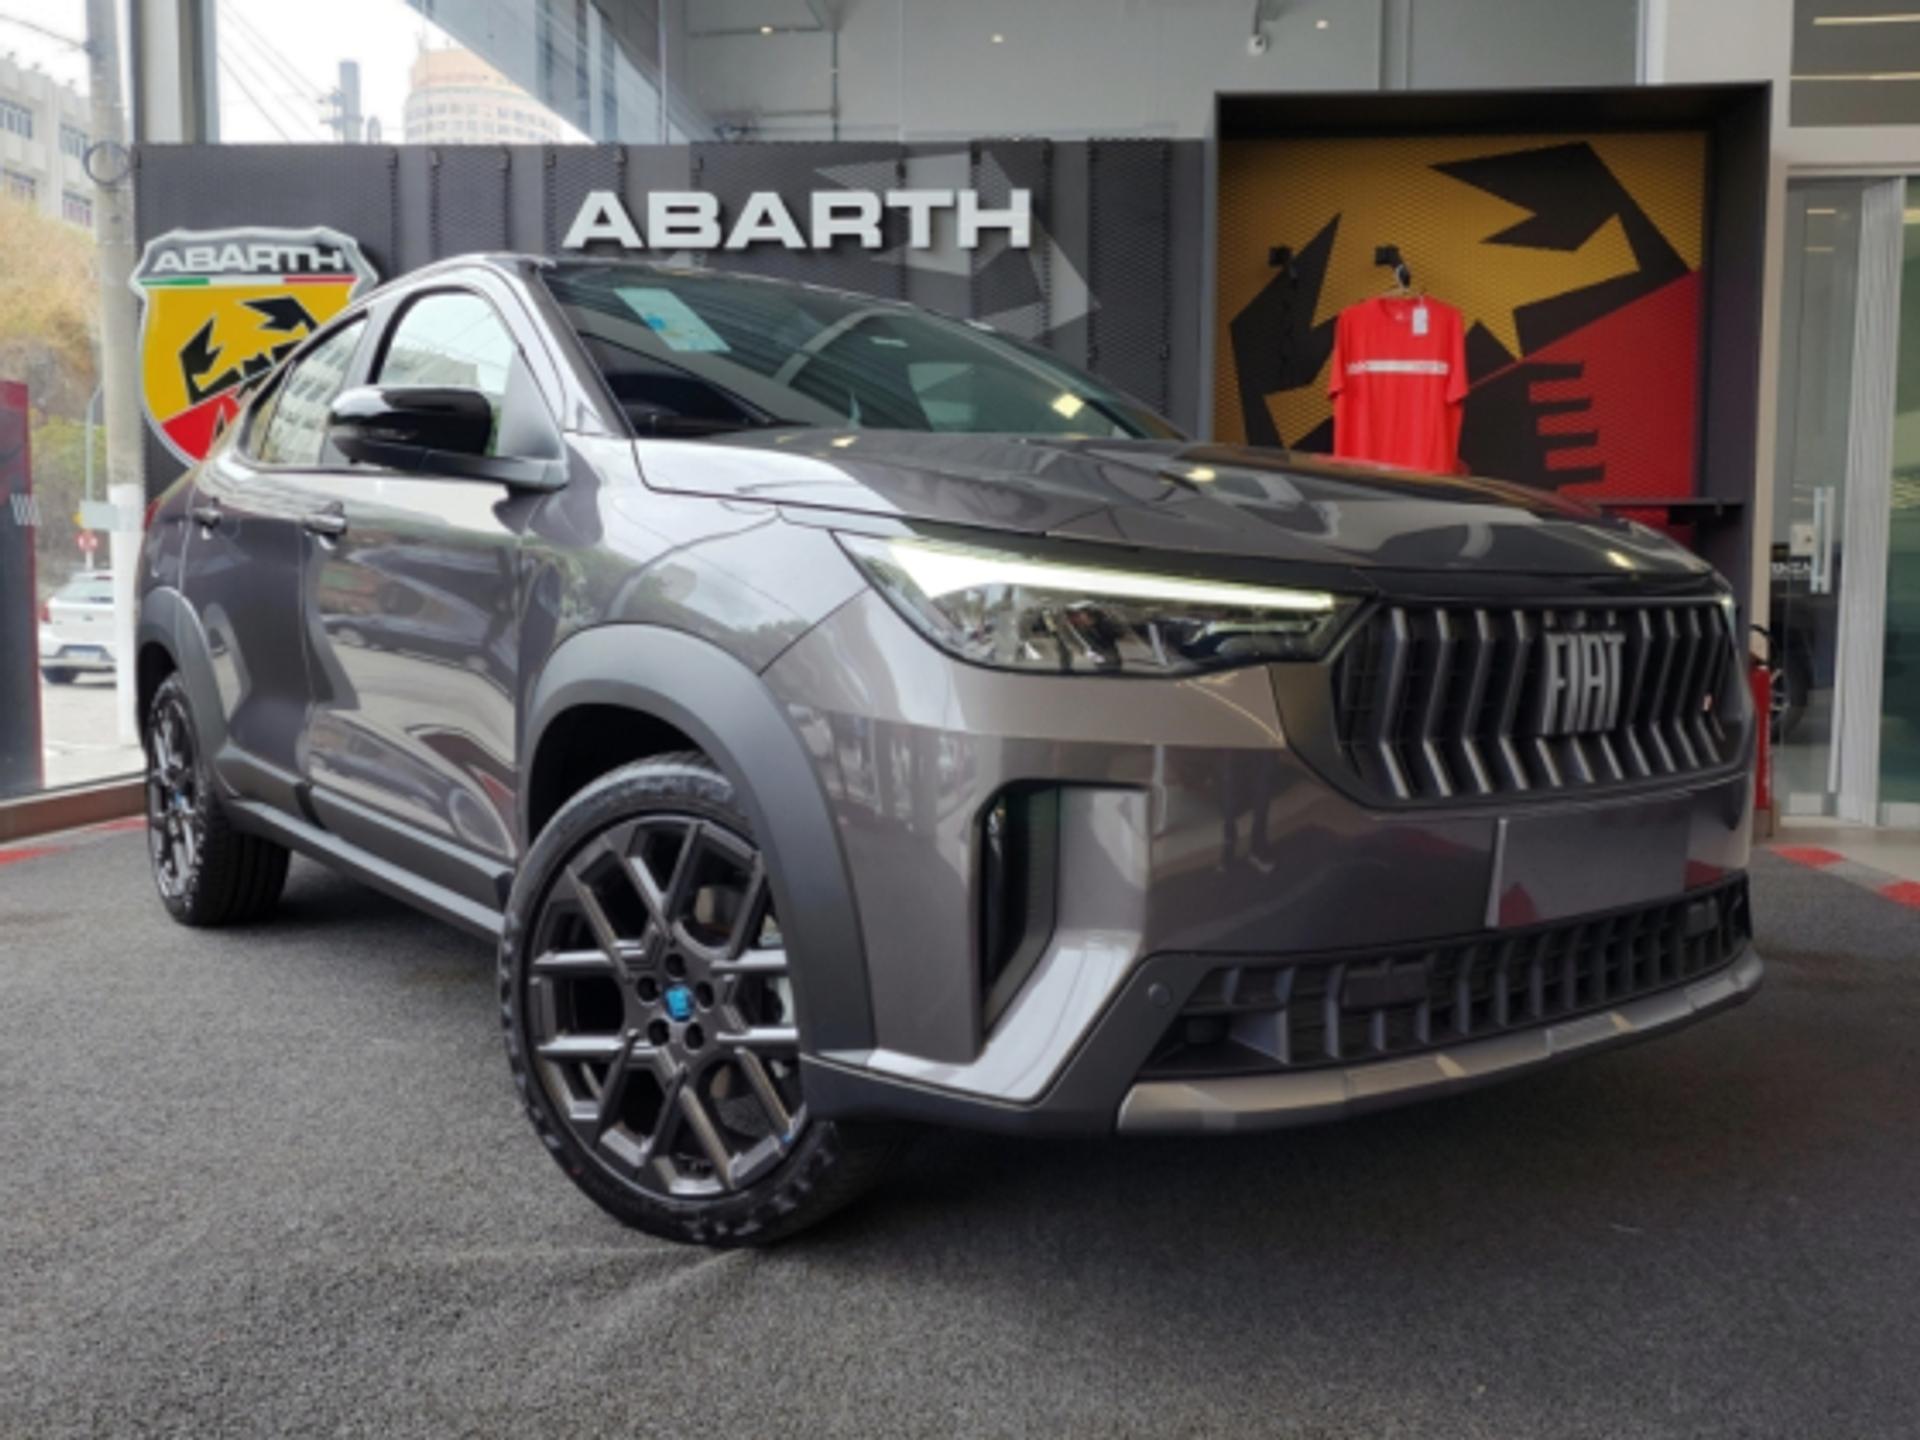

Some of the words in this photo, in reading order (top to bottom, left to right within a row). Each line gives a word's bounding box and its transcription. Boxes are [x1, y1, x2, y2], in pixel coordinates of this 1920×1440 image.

[562, 188, 1032, 249] ABARTH
[152, 243, 344, 273] ABARTH
[1542, 632, 1627, 735] FIAT
